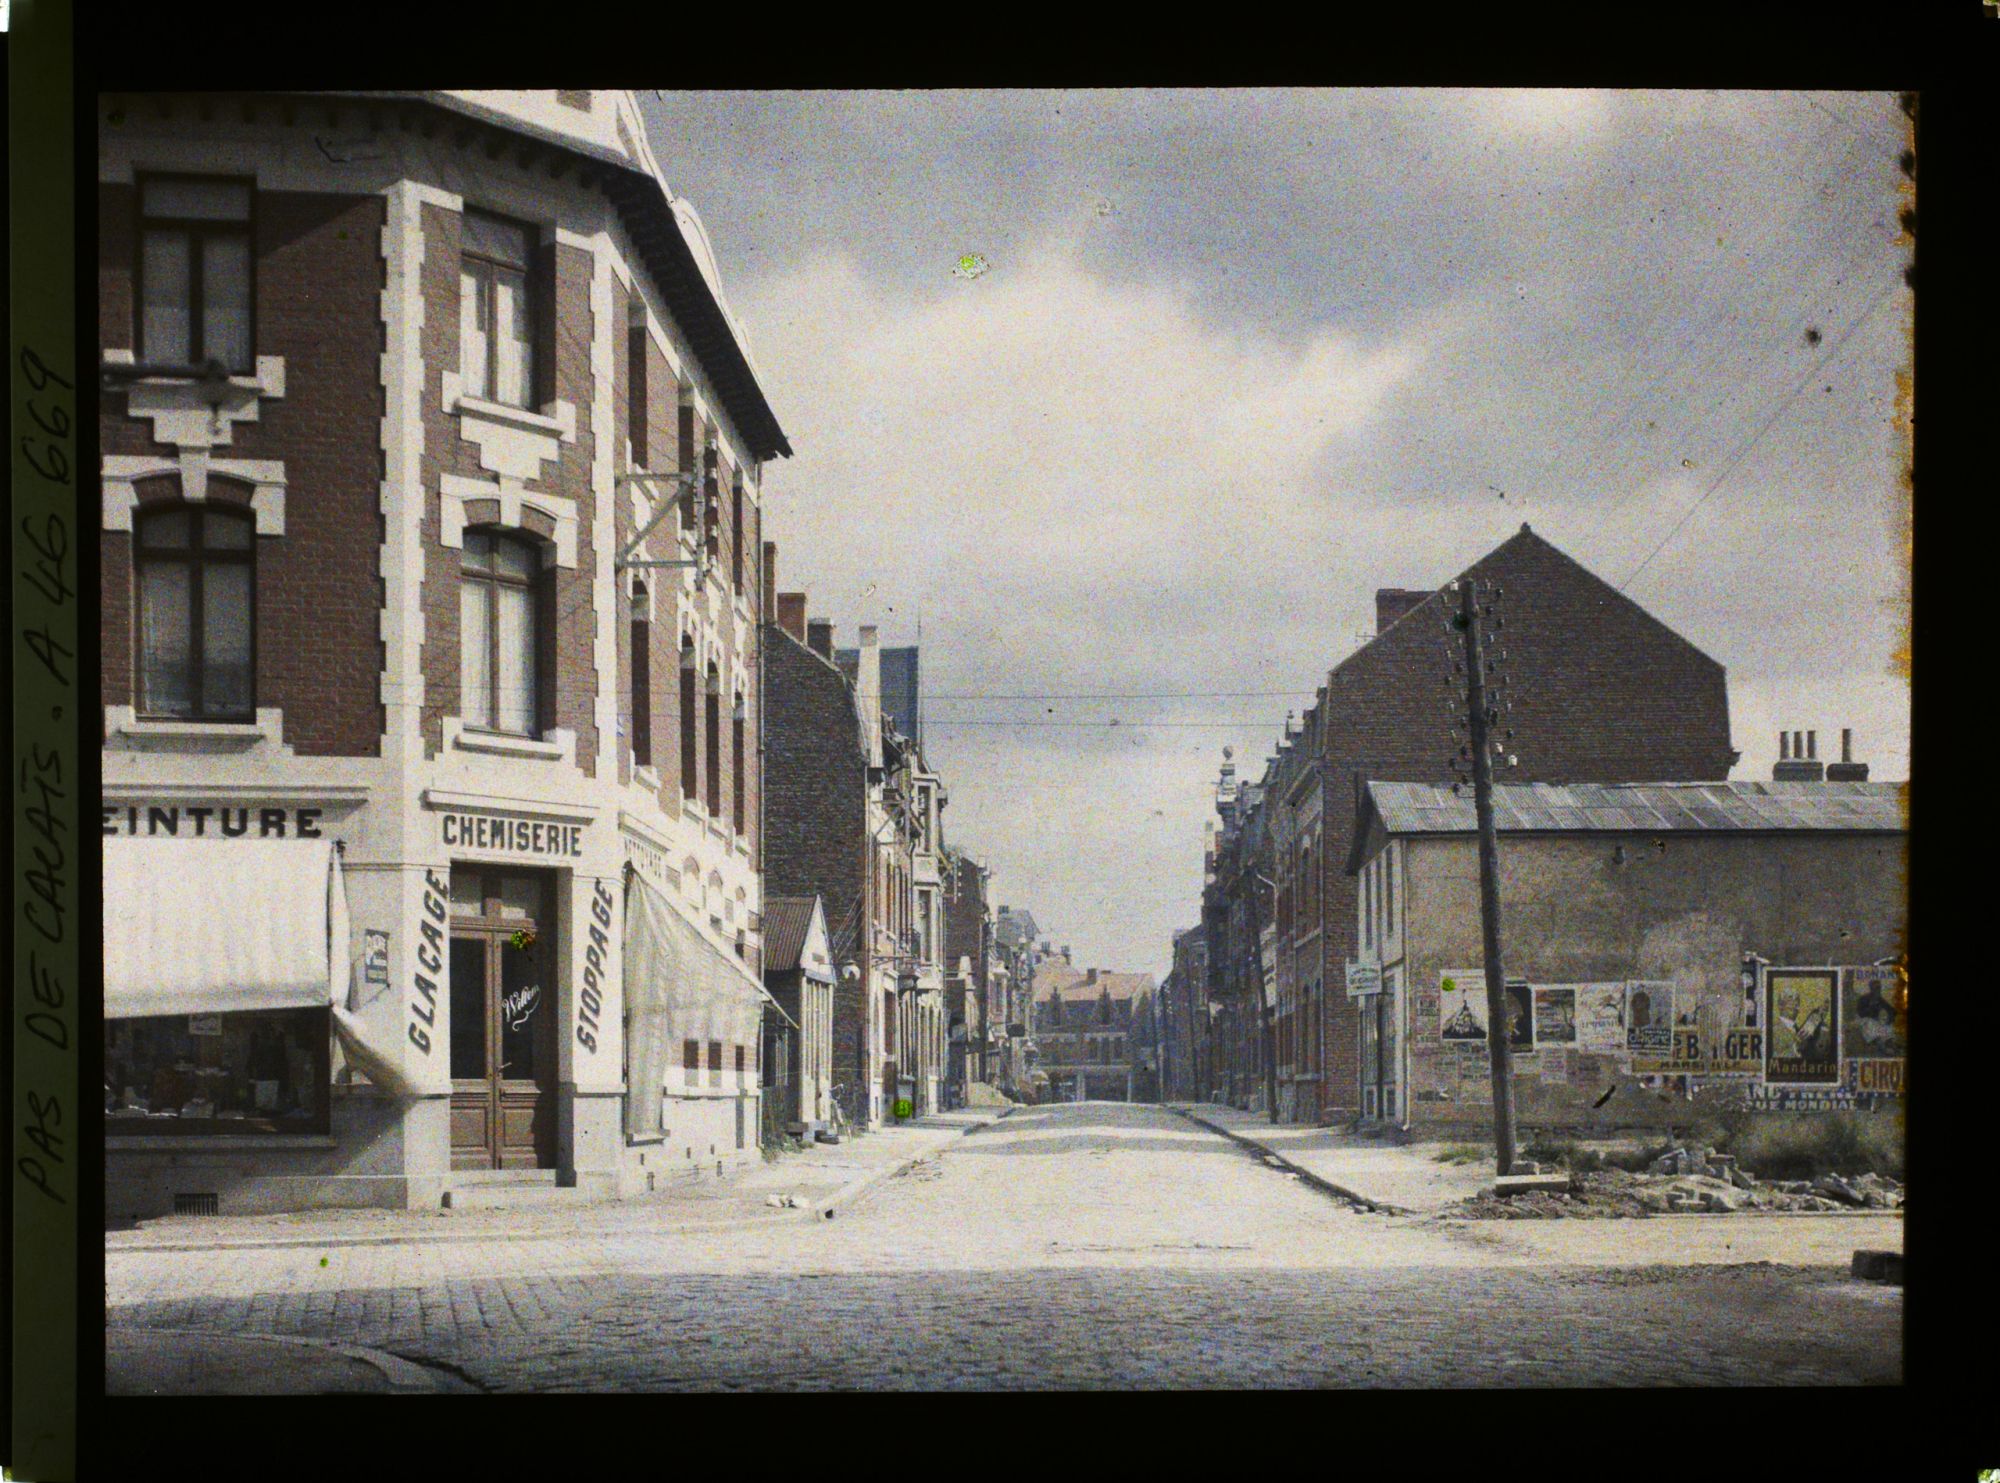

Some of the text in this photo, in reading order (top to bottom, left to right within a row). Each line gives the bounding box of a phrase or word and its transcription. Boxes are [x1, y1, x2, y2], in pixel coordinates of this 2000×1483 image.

[22, 624, 74, 687] A
[102, 806, 322, 838] EINTURE
[442, 814, 583, 857] CHEMISERIE
[623, 836, 663, 879] NETTOYAGE
[408, 868, 449, 1056] GLACAGE
[576, 876, 614, 1055] STOPPAGE
[25, 950, 69, 1050] DE
[1686, 1033, 1763, 1060] BGER
[1768, 1058, 1837, 1074] Mandarin
[1784, 1099, 1858, 1111] MONDIAL
[18, 1090, 67, 1204] PAS
